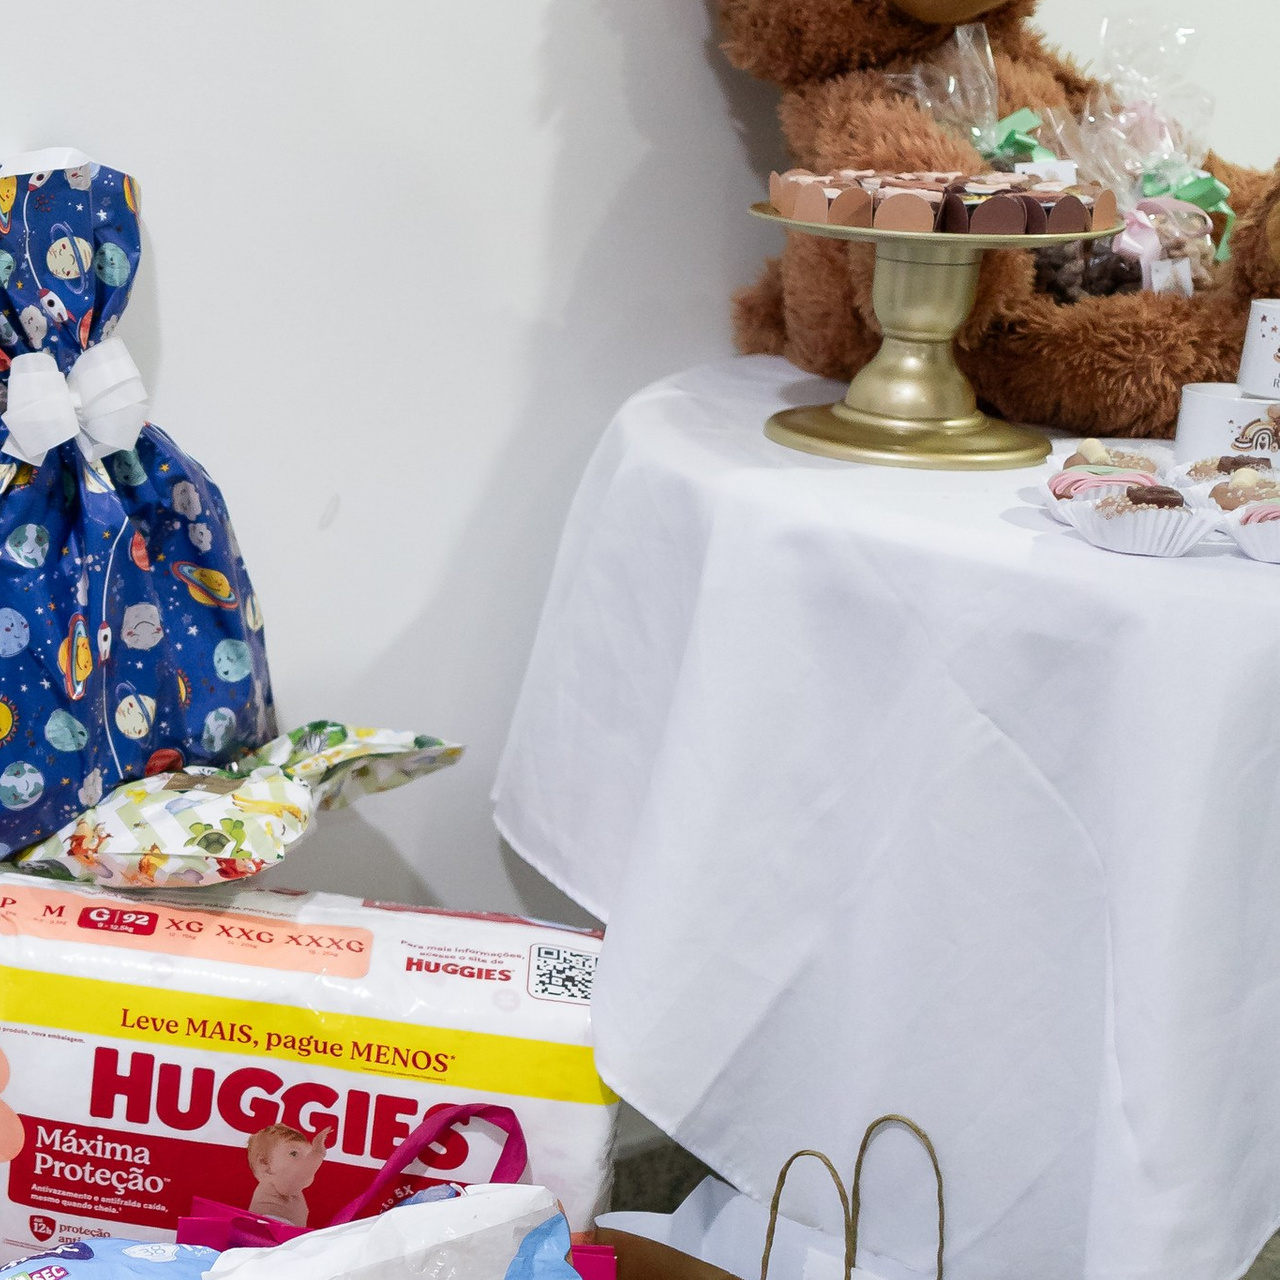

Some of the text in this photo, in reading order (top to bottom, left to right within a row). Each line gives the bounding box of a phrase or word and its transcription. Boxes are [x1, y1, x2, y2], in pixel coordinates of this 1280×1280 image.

[0, 896, 17, 909] P
[42, 905, 66, 918] M
[122, 913, 150, 927] 92
[164, 918, 204, 933] XG
[215, 924, 275, 944] XXG
[284, 934, 365, 954] XXXG
[400, 939, 424, 950] Para
[426, 945, 452, 953] mais
[468, 955, 487, 964] site
[490, 957, 504, 965] de
[405, 956, 513, 982] HUGGIES
[120, 1007, 179, 1034] Leve
[185, 1017, 259, 1049] MAIS,
[265, 1029, 344, 1058] pague
[89, 1046, 470, 1170] HUGGIES
[35, 1125, 151, 1165] Máxima
[394, 1184, 414, 1199] 5X
[30, 1193, 60, 1204] mesmo
[61, 1198, 93, 1210] quando
[32, 1221, 53, 1236] 12h
[59, 1222, 111, 1239] proteção
